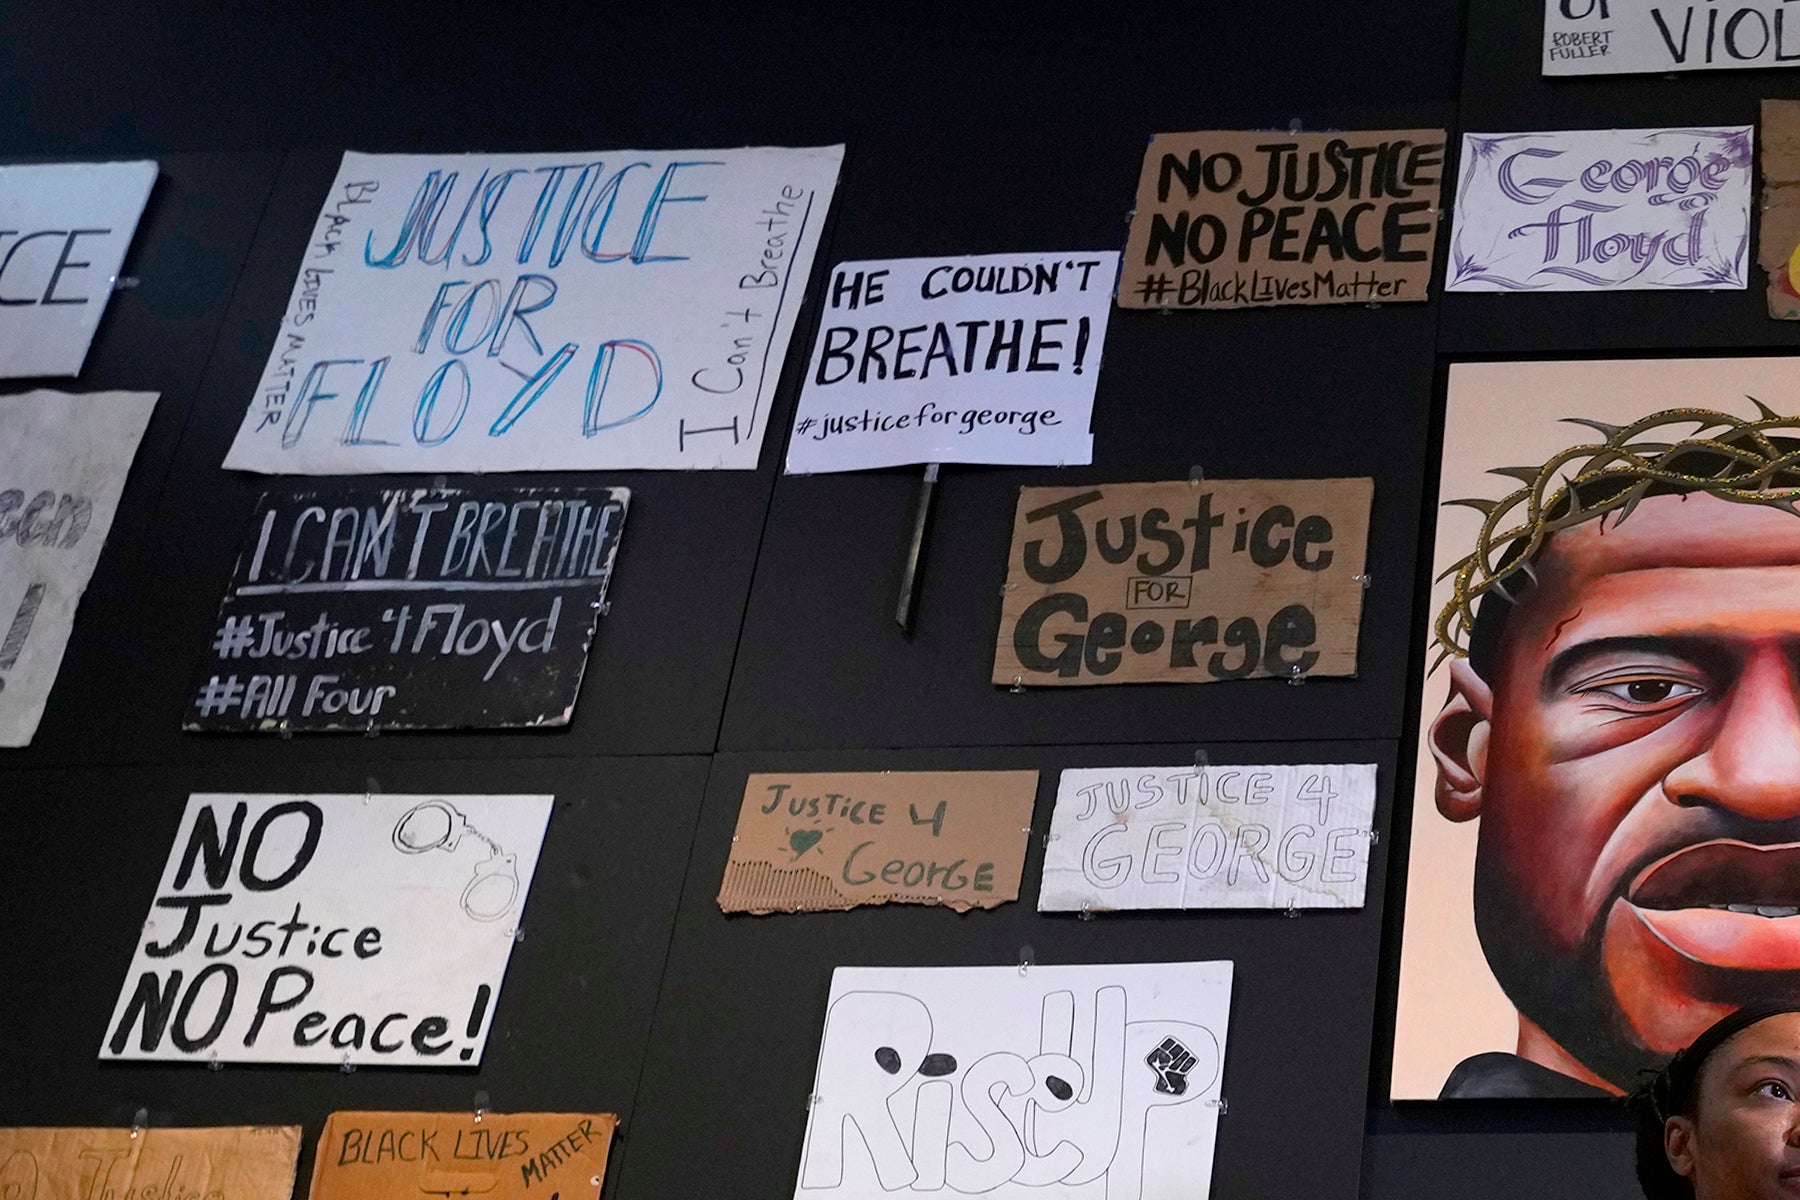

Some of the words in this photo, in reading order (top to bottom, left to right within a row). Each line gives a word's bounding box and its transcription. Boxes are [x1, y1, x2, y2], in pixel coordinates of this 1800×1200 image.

[1549, 45, 1611, 61] FULLER
[1553, 30, 1614, 46] ROBERT
[1157, 151, 1241, 202] NO
[1237, 141, 1442, 206] JUSTICE
[1498, 143, 1731, 212] George
[366, 161, 725, 269] JUSTICE
[1145, 211, 1226, 267] NO
[1239, 200, 1431, 265] PEACE
[415, 275, 558, 358] FOR
[679, 417, 740, 450] I
[740, 185, 804, 293] Breathe
[830, 269, 890, 309] HE
[921, 259, 1101, 299] COULDN'T
[256, 332, 306, 433] MATTER
[815, 316, 1091, 386] BREATHE!
[281, 340, 664, 448] FLOYD
[796, 404, 1062, 440] #justiceforgeorge
[248, 508, 277, 583] I
[441, 498, 622, 578] BREATHE
[1023, 491, 1334, 585] Justice
[1133, 578, 1186, 604] FOR
[212, 611, 375, 660] #Justice
[382, 603, 413, 646] 4
[411, 595, 563, 682] Floyd
[1013, 592, 1320, 679] George
[195, 674, 297, 717] #All
[301, 674, 396, 717] Four
[908, 800, 948, 836] 4
[1075, 774, 1276, 823] JUSTICE
[1296, 775, 1340, 825] 4
[173, 800, 324, 893] NO
[1082, 822, 1360, 890] GEORGE
[145, 894, 383, 960] Justice
[109, 964, 240, 1056] NO
[243, 965, 492, 1060] Peace!
[337, 1128, 440, 1167] BLACK
[454, 1128, 530, 1160] LIVES
[520, 1119, 603, 1188] MATTER
